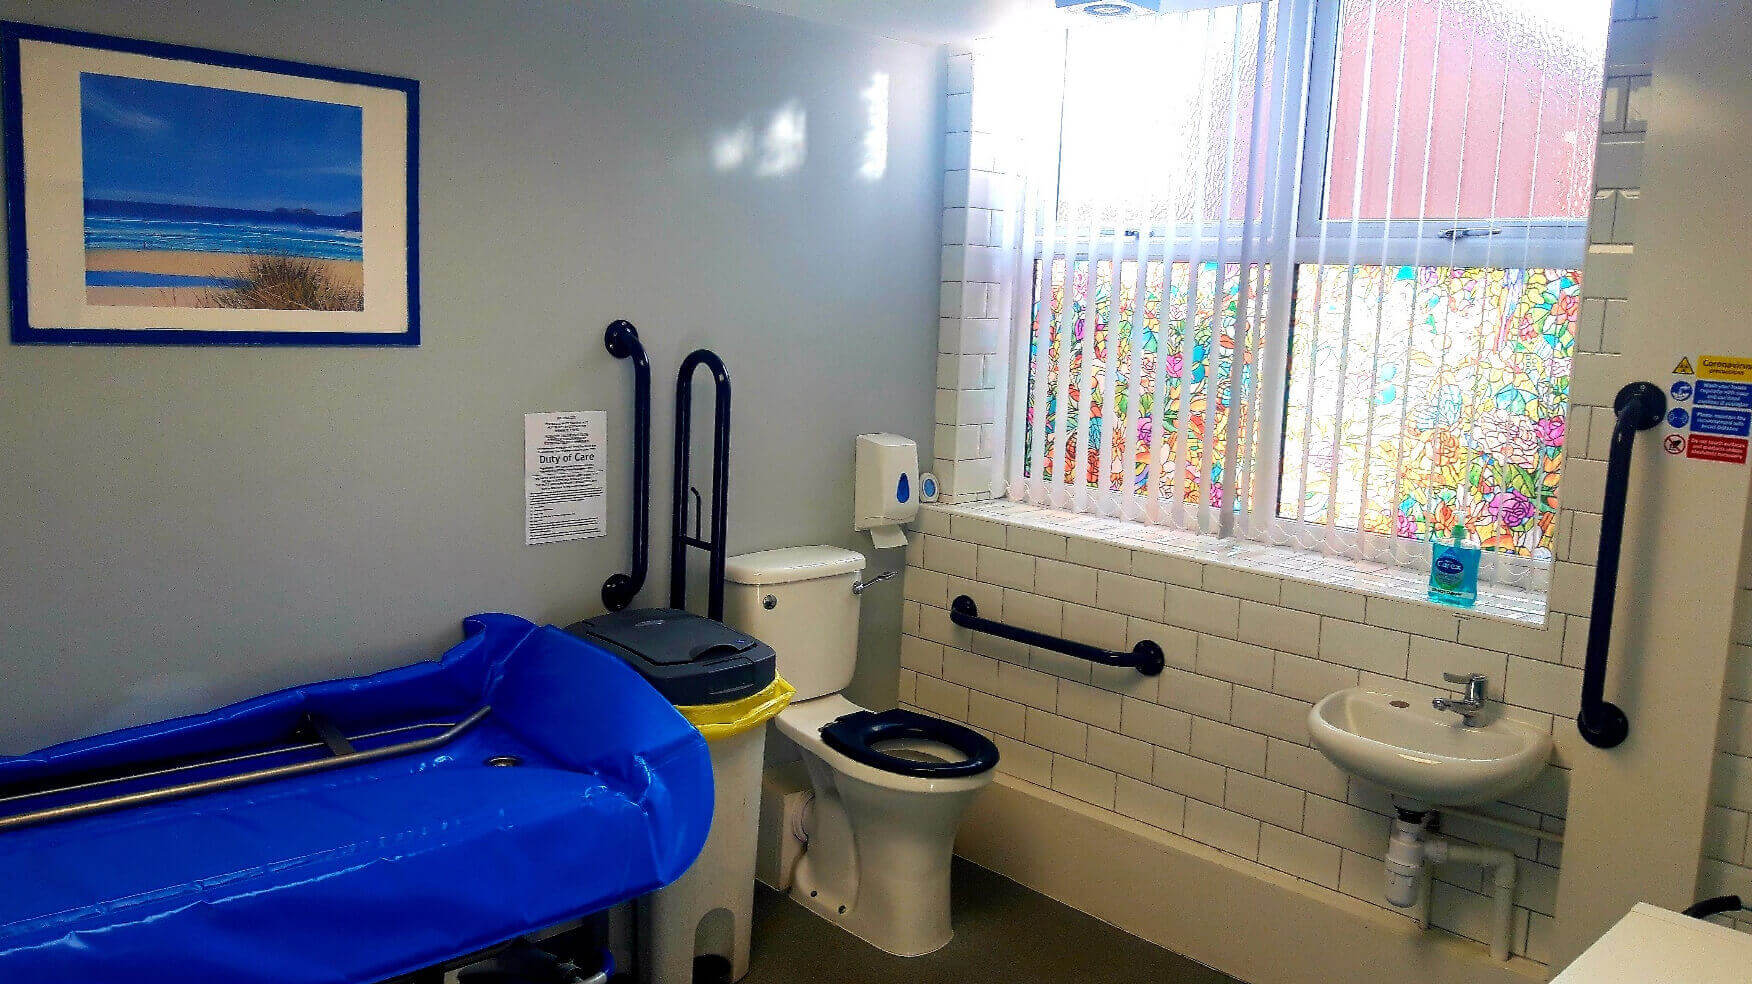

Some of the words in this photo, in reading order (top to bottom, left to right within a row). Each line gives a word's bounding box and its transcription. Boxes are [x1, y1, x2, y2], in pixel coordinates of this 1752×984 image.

[540, 455, 560, 464] Duty
[563, 453, 572, 462] of
[574, 452, 595, 461] Care
